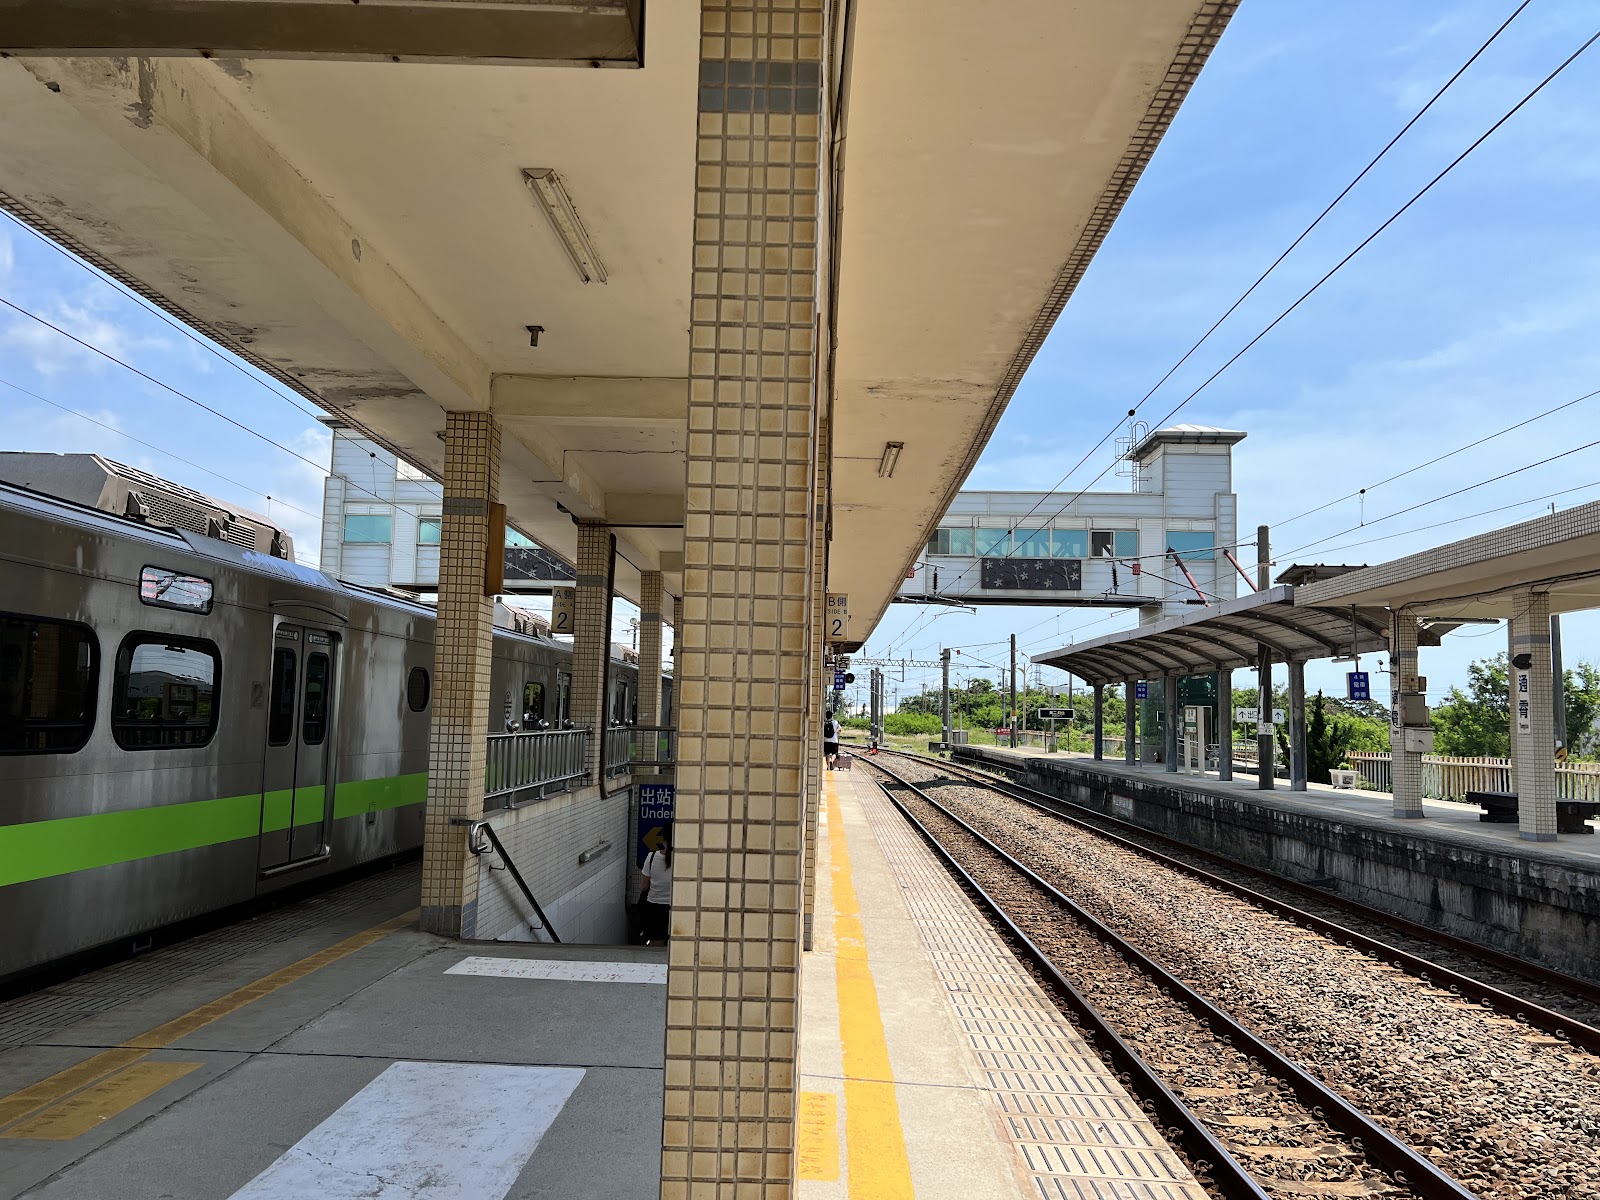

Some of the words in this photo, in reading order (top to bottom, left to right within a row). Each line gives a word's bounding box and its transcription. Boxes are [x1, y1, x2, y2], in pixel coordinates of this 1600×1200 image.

[556, 612, 568, 629] 2
[831, 618, 842, 636] 2
[640, 787, 675, 806] 出站
